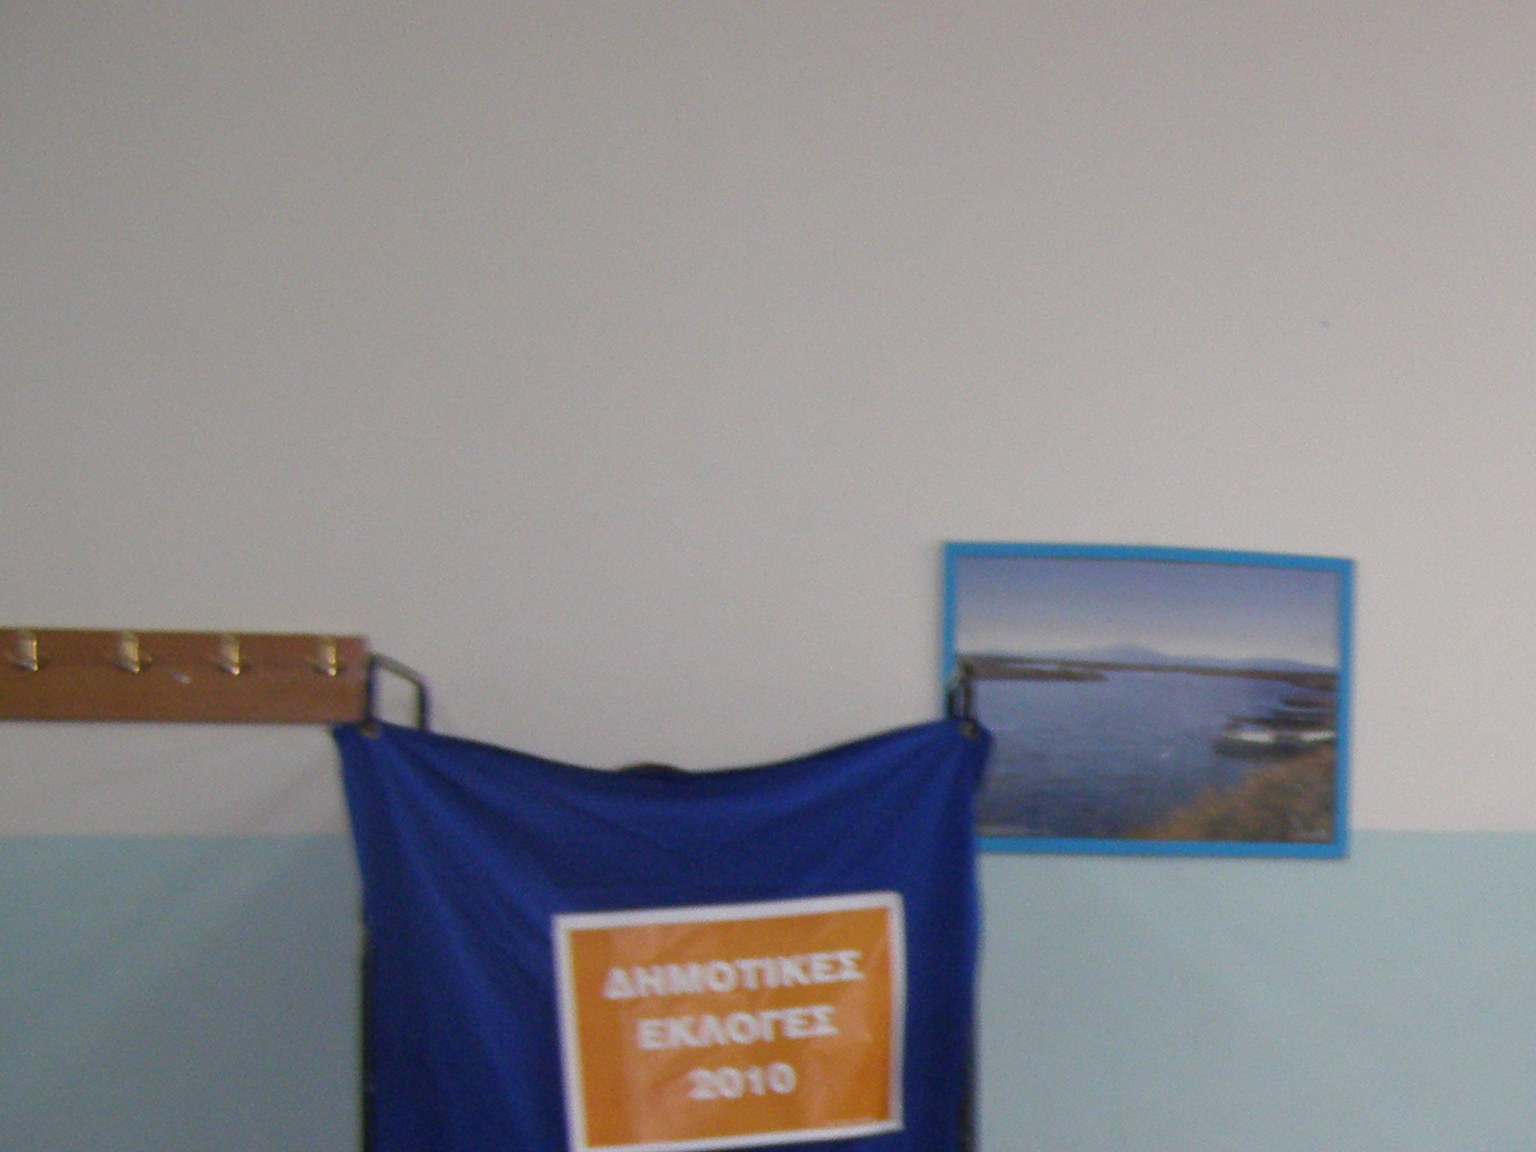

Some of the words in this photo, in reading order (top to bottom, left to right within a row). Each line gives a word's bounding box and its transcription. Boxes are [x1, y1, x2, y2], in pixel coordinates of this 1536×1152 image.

[604, 950, 865, 1000] ΔΗΜΟΤΙΚΕΣ
[639, 1005, 839, 1050] ΕΚΛΟΓΕΣ
[688, 1062, 798, 1100] 2010
